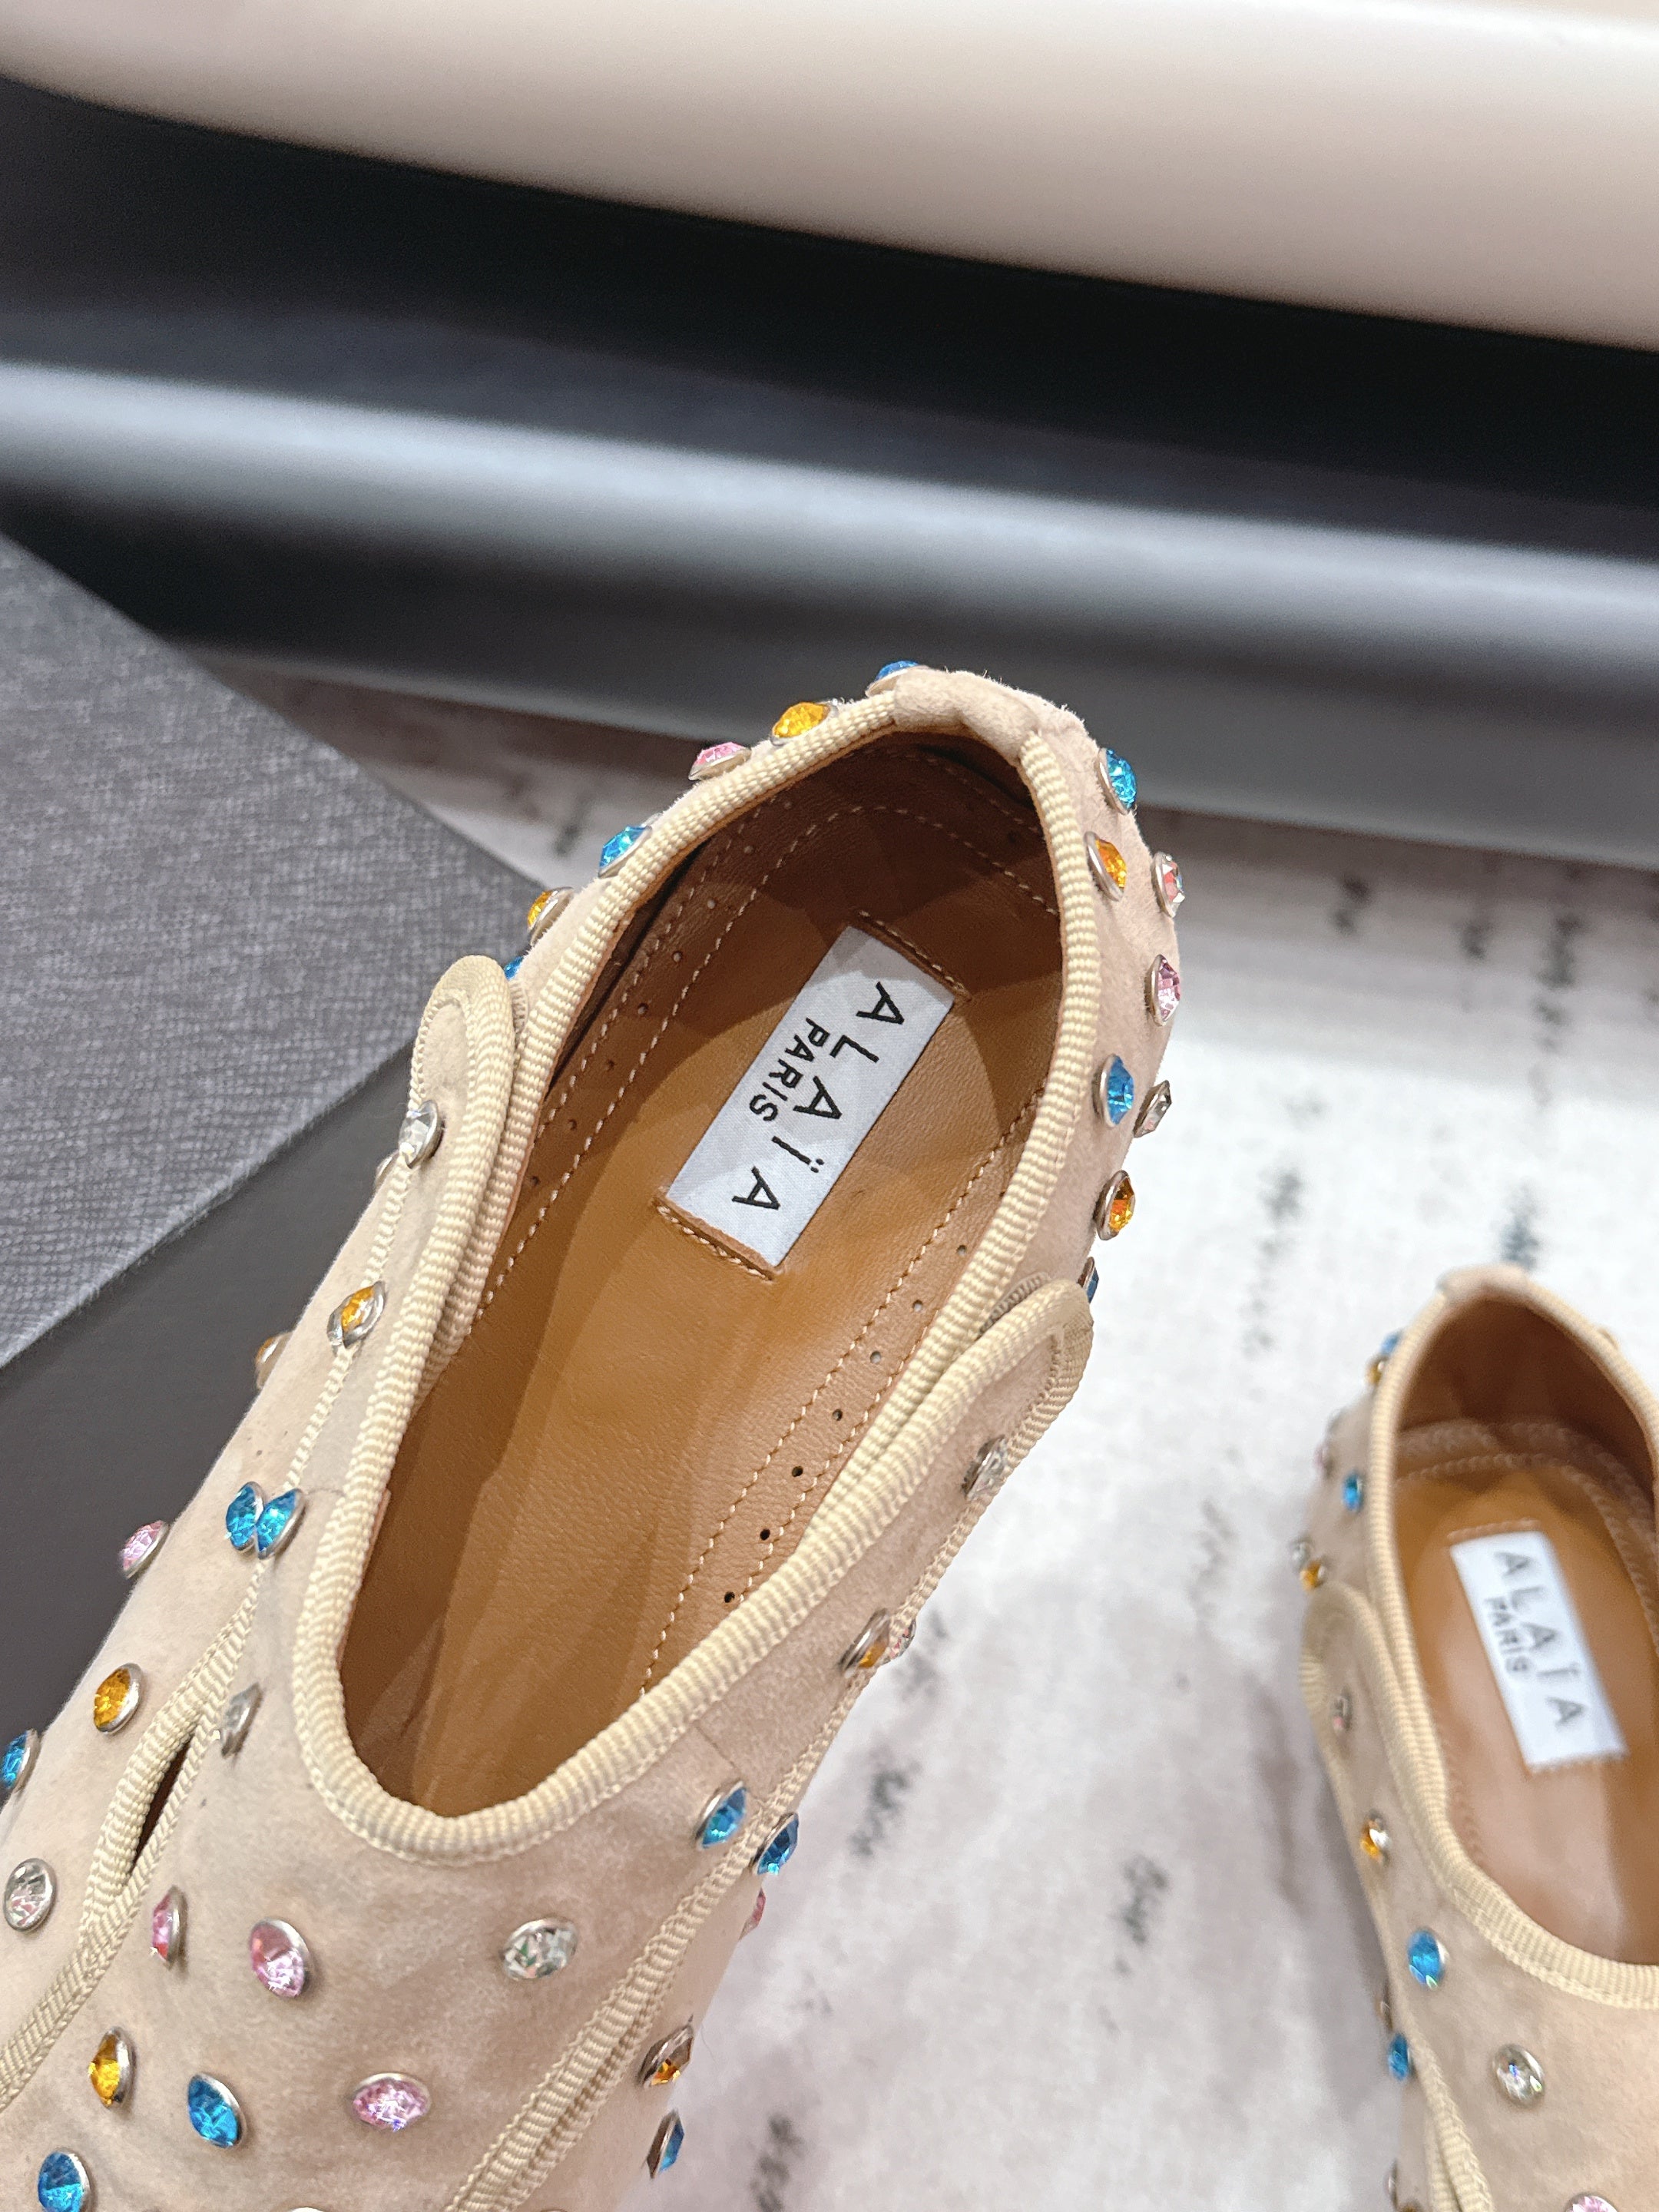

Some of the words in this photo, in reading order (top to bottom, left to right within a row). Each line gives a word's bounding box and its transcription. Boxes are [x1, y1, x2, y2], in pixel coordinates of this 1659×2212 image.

[732, 982, 905, 1210] ALAÏA
[750, 1018, 830, 1121] PARIS
[1485, 1597, 1534, 1677] PARIS
